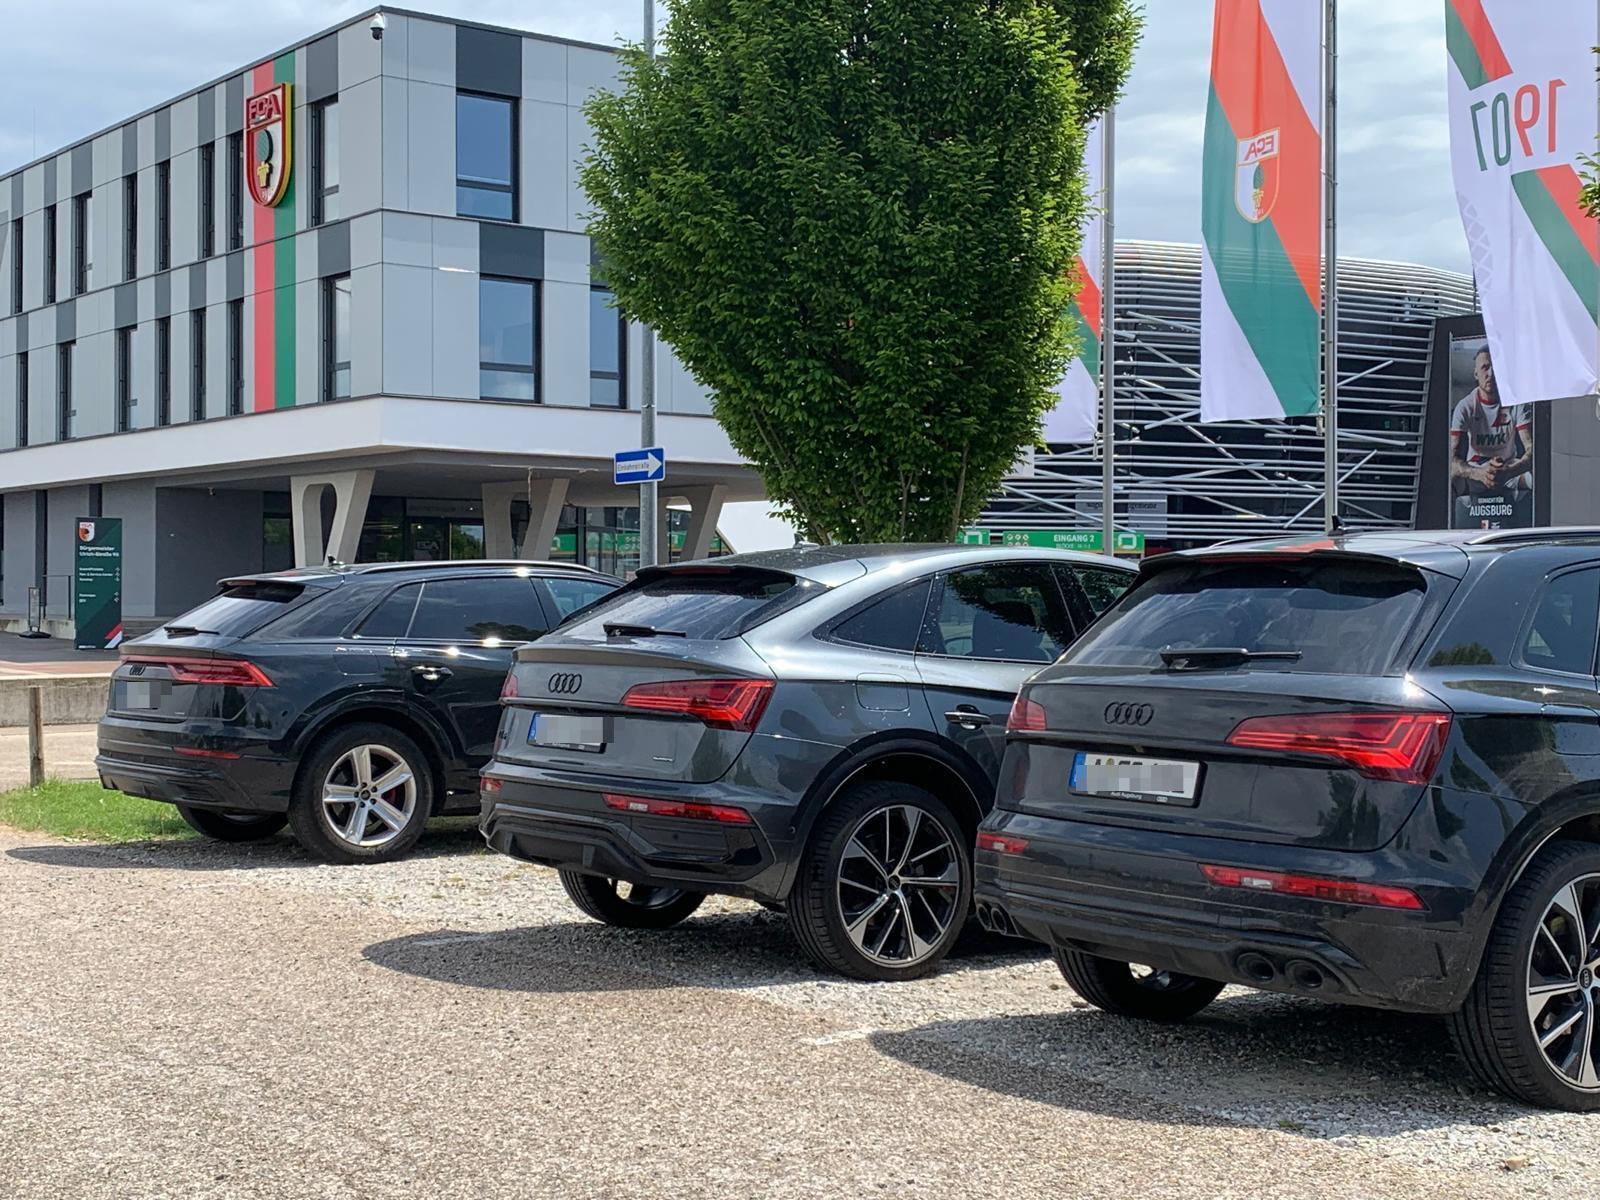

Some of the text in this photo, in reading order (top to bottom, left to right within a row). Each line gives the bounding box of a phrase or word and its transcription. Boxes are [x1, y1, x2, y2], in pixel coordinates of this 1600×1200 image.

[249, 94, 281, 121] FCA
[1476, 433, 1506, 445] WWK
[1470, 505, 1512, 516] AUGSBURG
[1053, 534, 1095, 543] EINGANG 2
[1121, 792, 1142, 800] Augsburg
